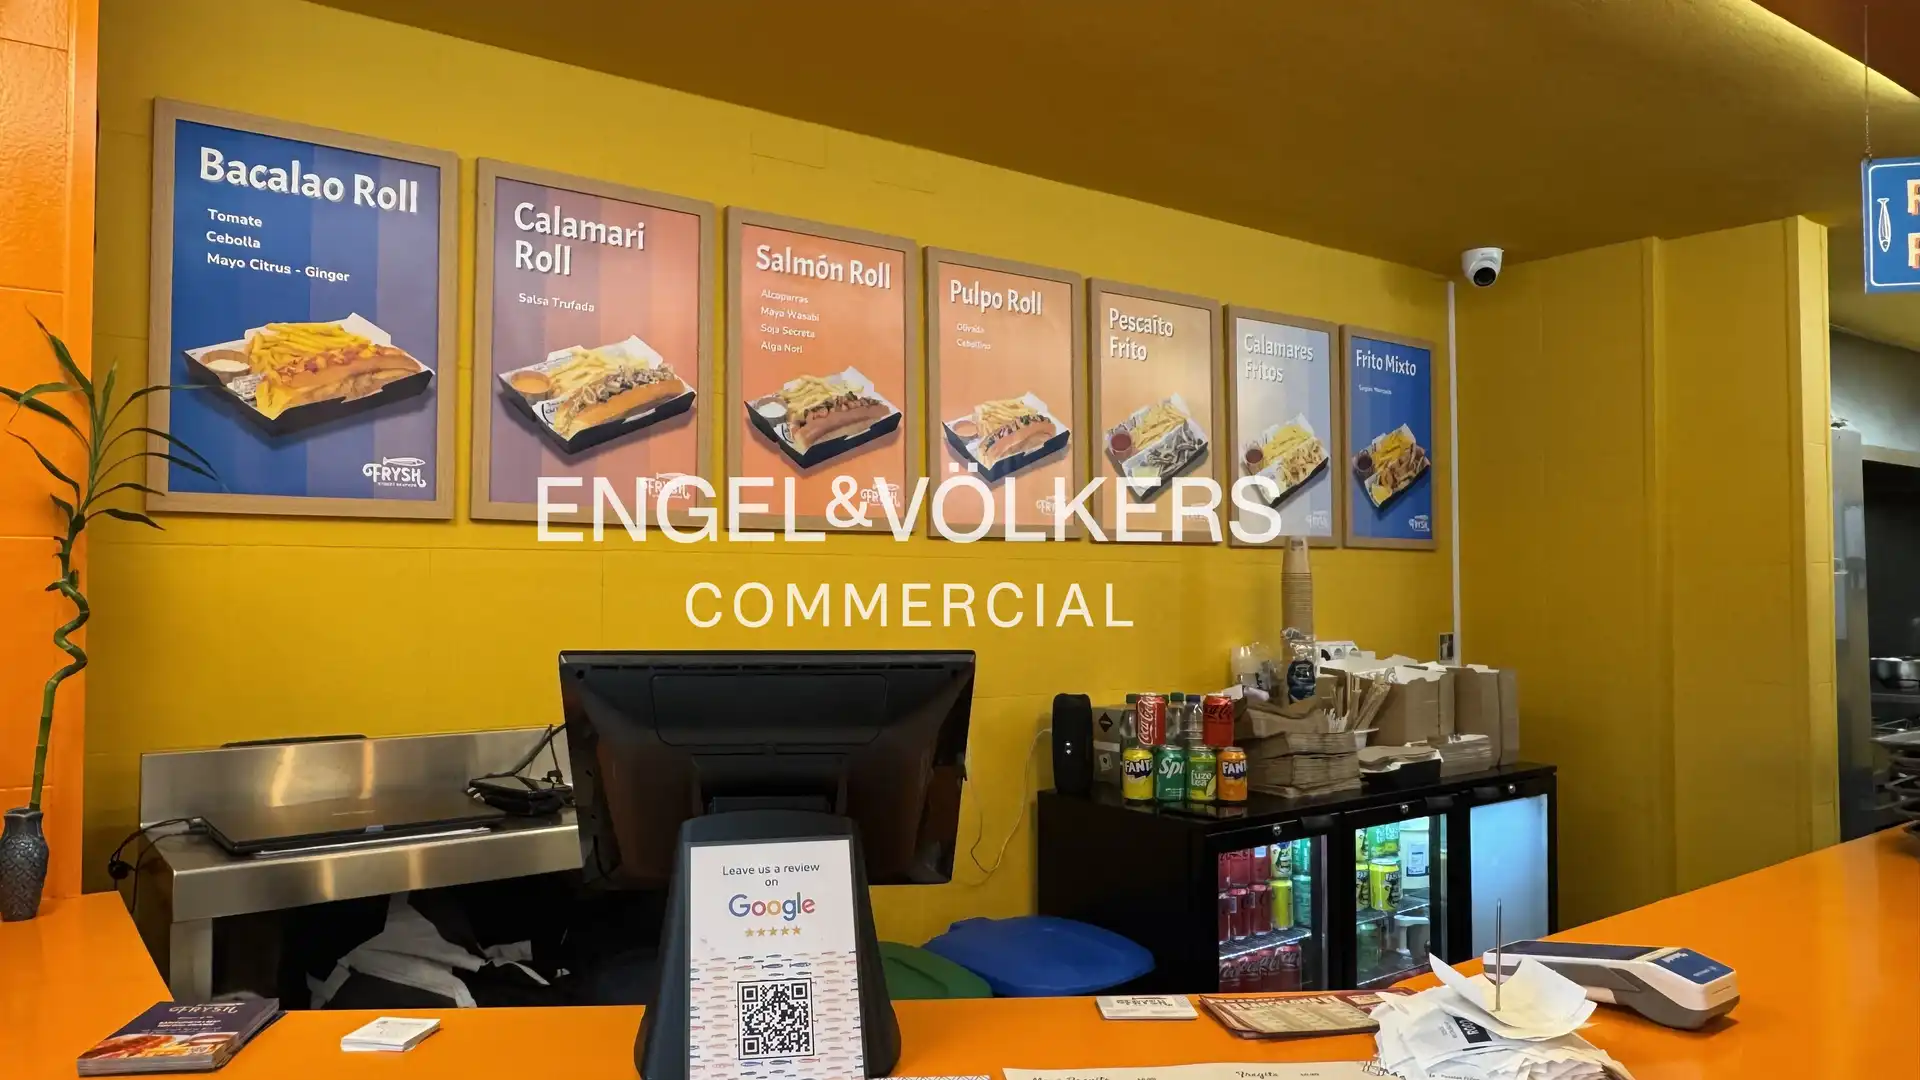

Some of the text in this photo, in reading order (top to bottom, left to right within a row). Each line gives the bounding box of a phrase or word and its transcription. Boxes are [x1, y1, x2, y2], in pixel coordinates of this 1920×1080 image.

[200, 146, 418, 213] Bacalao Roll
[207, 208, 263, 228] Tomate
[514, 201, 645, 250] Calamari
[206, 230, 261, 249] Cebolla
[207, 252, 245, 270] Mayo
[250, 258, 291, 275] Citrus
[305, 266, 350, 282] Ginger
[515, 239, 571, 276] Roll
[756, 244, 891, 289] Salmón Roll
[519, 292, 595, 312] Salsa Trufada
[950, 279, 1042, 316] Pulpo Roll
[787, 308, 820, 322] Wasabi
[1109, 307, 1174, 337] Pescaíto
[761, 341, 782, 354] Alga
[1109, 335, 1148, 362] Frito
[1244, 333, 1315, 361] Calamares
[1245, 359, 1285, 383] Fritos
[1356, 348, 1417, 377] Frito Mixto
[362, 462, 427, 488] FRYSH
[722, 862, 820, 876] Leave us a review
[764, 878, 779, 887] on
[728, 891, 816, 922] Google
